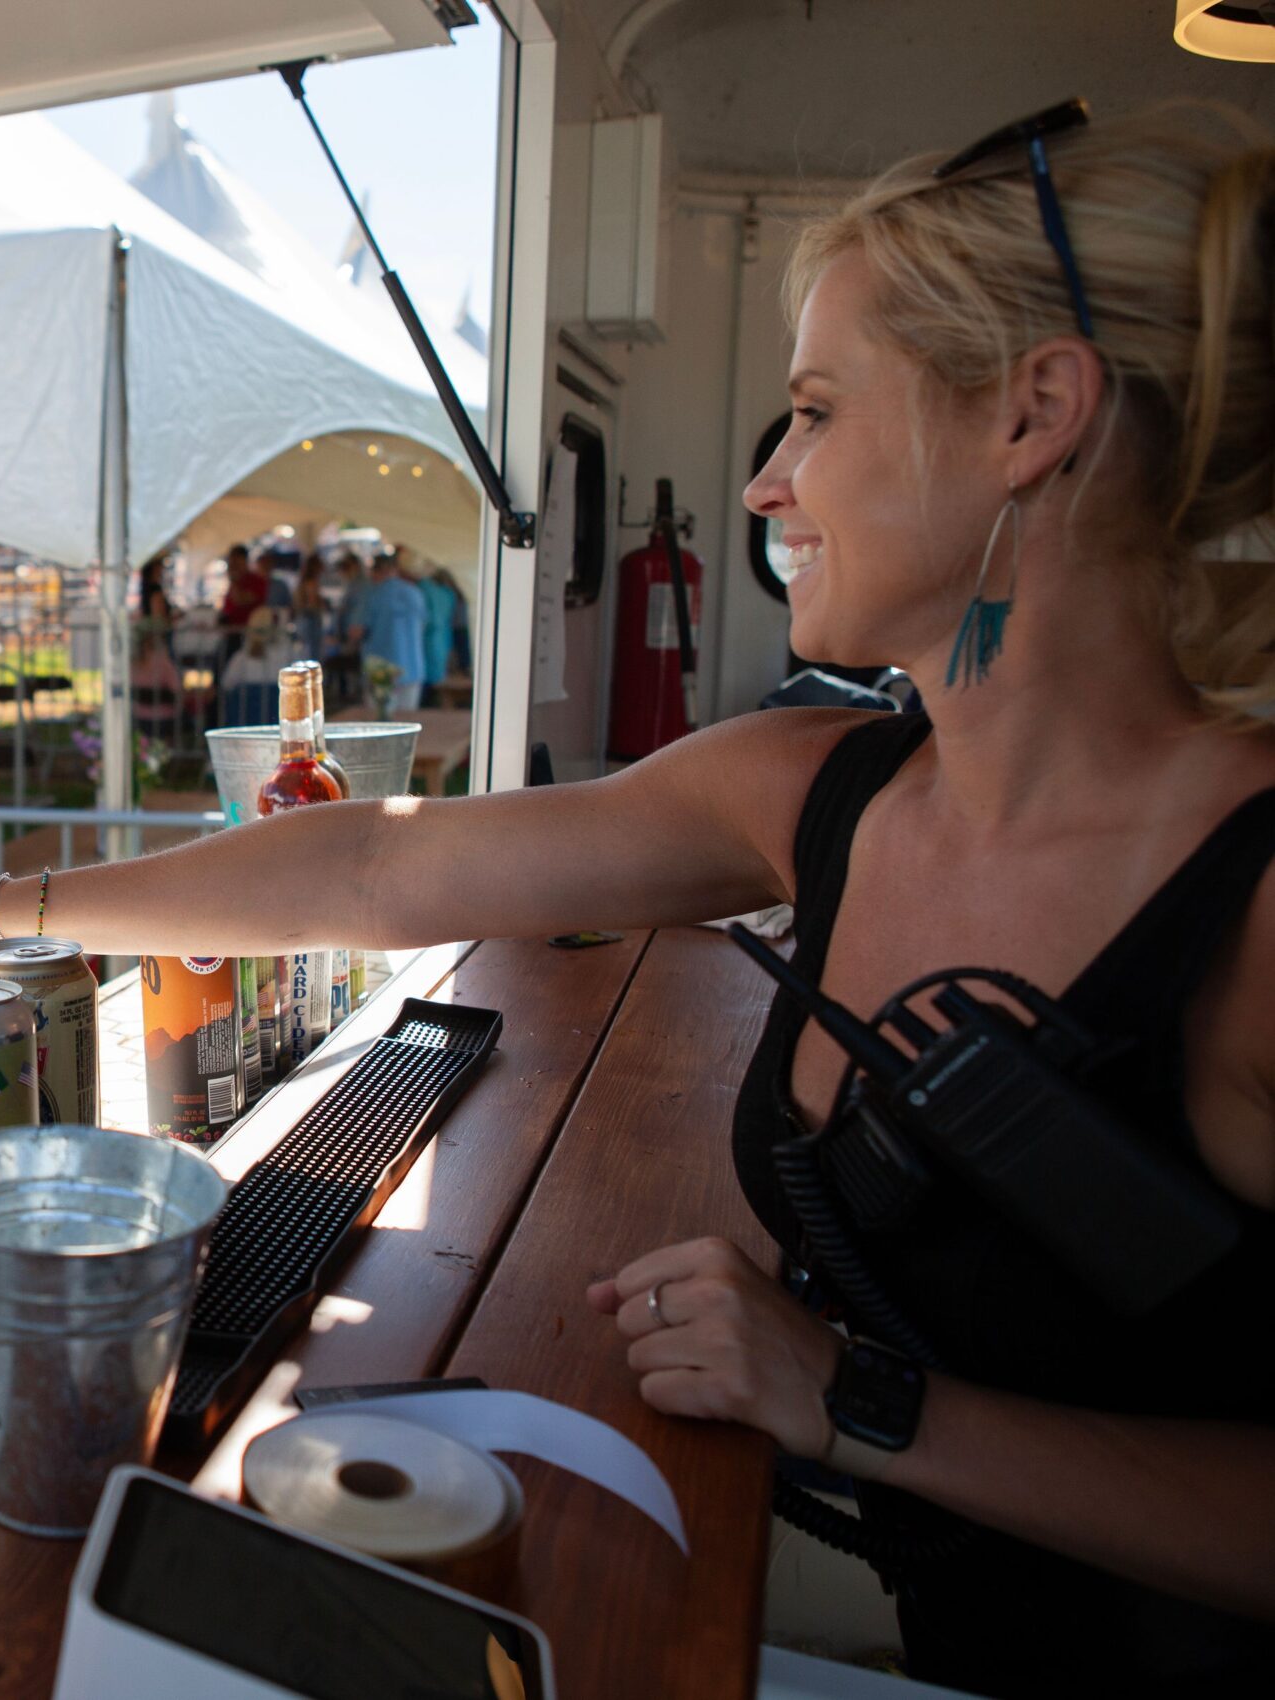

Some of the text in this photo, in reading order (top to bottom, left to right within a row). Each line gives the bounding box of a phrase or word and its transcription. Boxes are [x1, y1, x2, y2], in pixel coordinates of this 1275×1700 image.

[186, 957, 224, 973] HARD CIDER
[292, 954, 307, 1061] HARD CIDER
